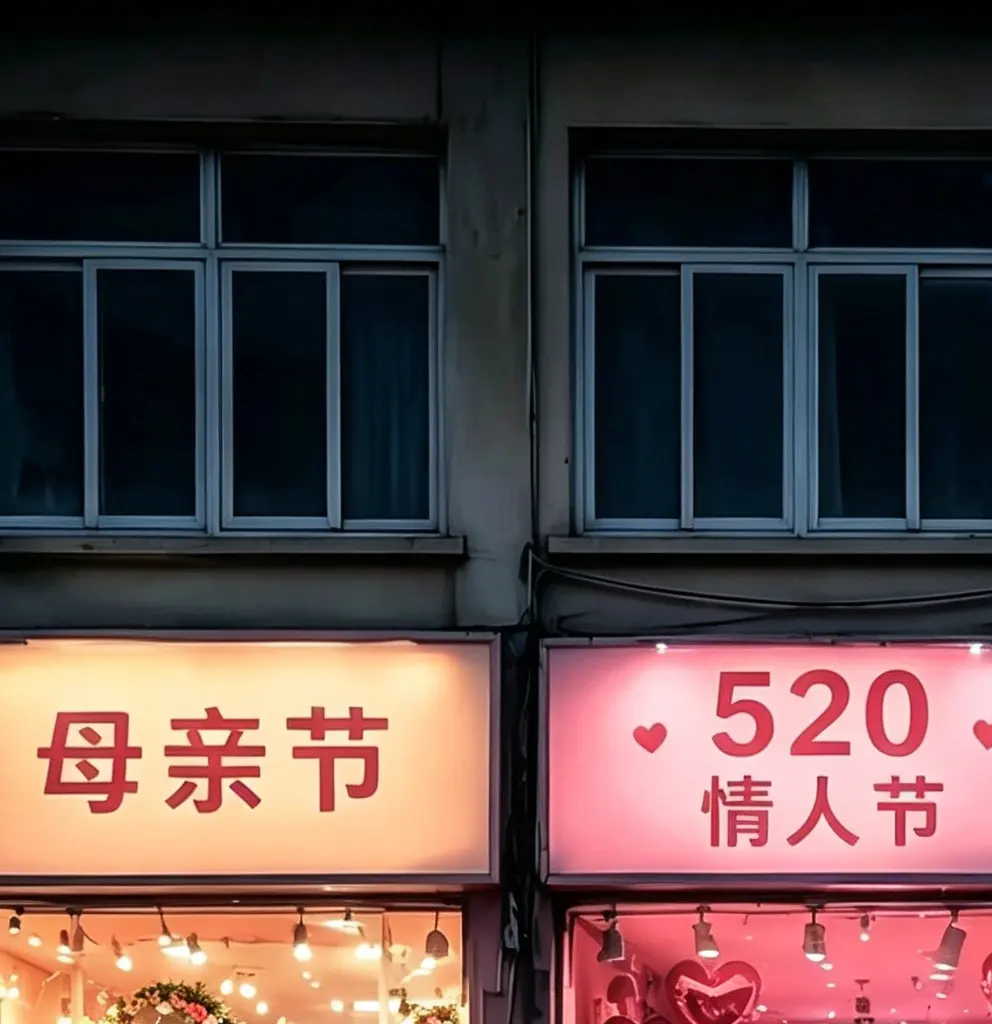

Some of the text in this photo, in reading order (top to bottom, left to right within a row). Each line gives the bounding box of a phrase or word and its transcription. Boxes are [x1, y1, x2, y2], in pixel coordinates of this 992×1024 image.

[712, 669, 929, 757] 520
[37, 706, 389, 814] 母亲节
[701, 775, 944, 847] 情人节
